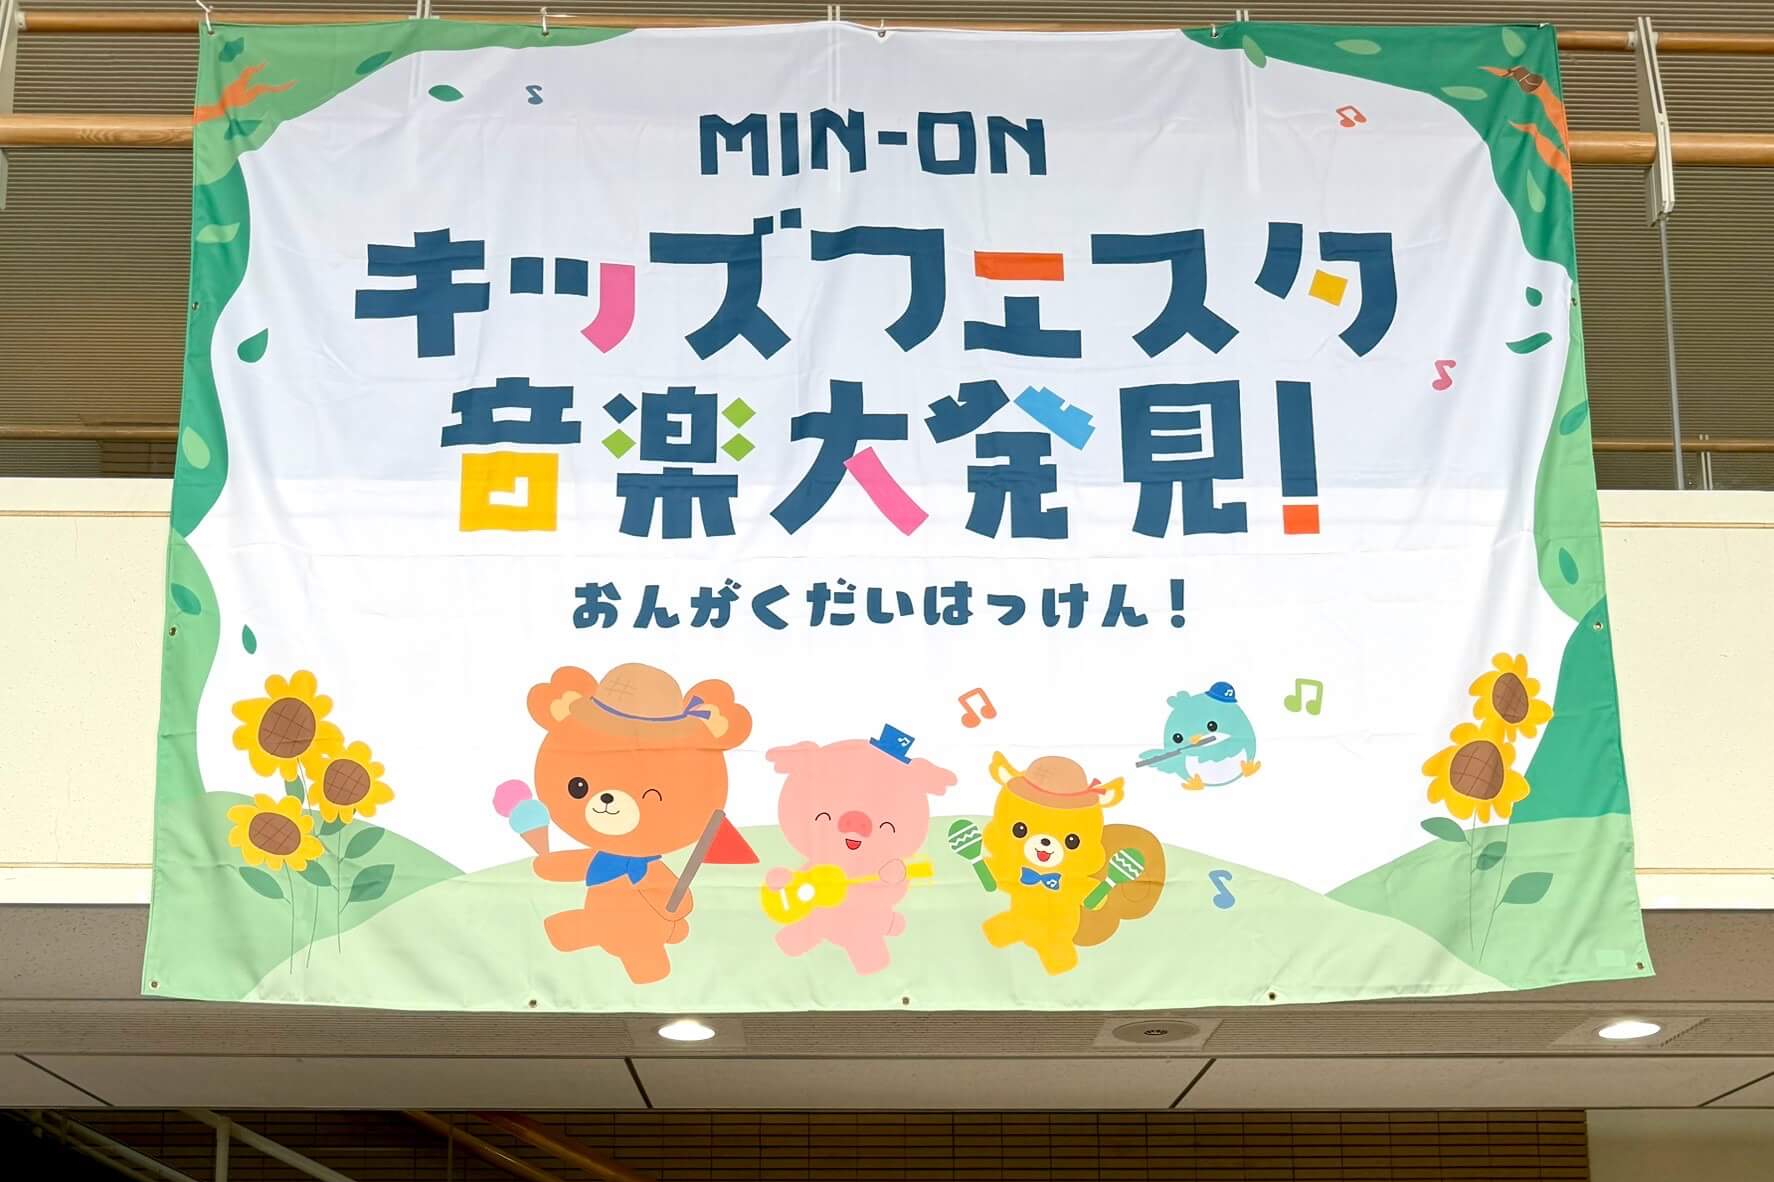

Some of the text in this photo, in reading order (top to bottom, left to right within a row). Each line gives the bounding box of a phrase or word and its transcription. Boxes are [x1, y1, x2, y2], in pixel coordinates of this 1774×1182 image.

[700, 109, 1047, 176] MIN-ON
[355, 208, 1397, 359] キッズフェスタ
[441, 376, 1321, 540] 音楽大発見!
[572, 578, 1188, 631] おんがくだいはっけん!
